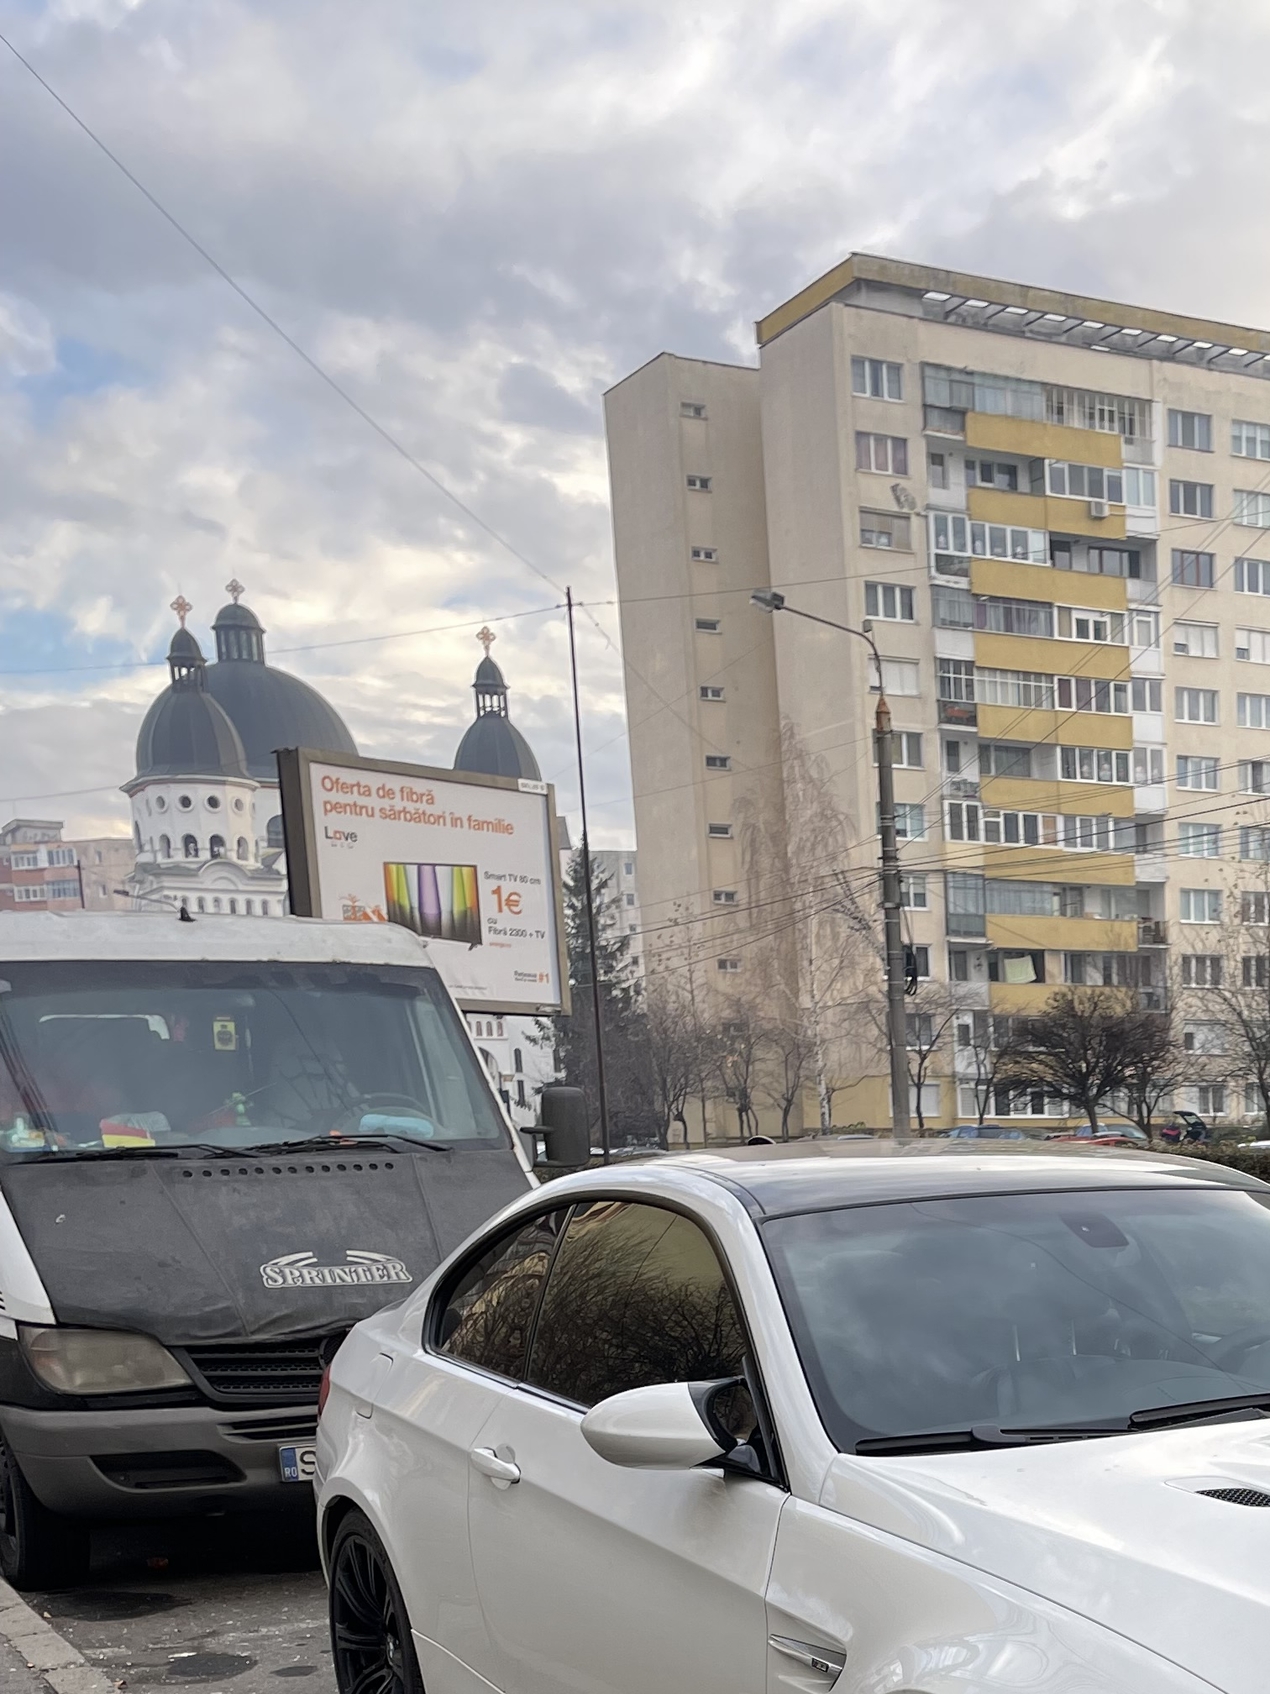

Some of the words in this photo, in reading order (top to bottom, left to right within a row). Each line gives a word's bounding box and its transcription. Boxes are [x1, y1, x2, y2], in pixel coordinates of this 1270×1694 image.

[321, 775, 371, 797] Oferta
[377, 784, 395, 800] de
[400, 786, 435, 806] fibră
[323, 799, 375, 818] pentru
[380, 805, 446, 827] sărbători
[450, 812, 463, 828] în
[467, 814, 514, 835] familie
[324, 826, 358, 843] Love
[484, 870, 507, 882] Smart
[508, 873, 518, 882] TV
[491, 885, 522, 915] 1€
[487, 917, 498, 925] cu
[535, 930, 546, 940] TV
[263, 1261, 411, 1287] SPRINTER
[284, 1467, 298, 1478] RO
